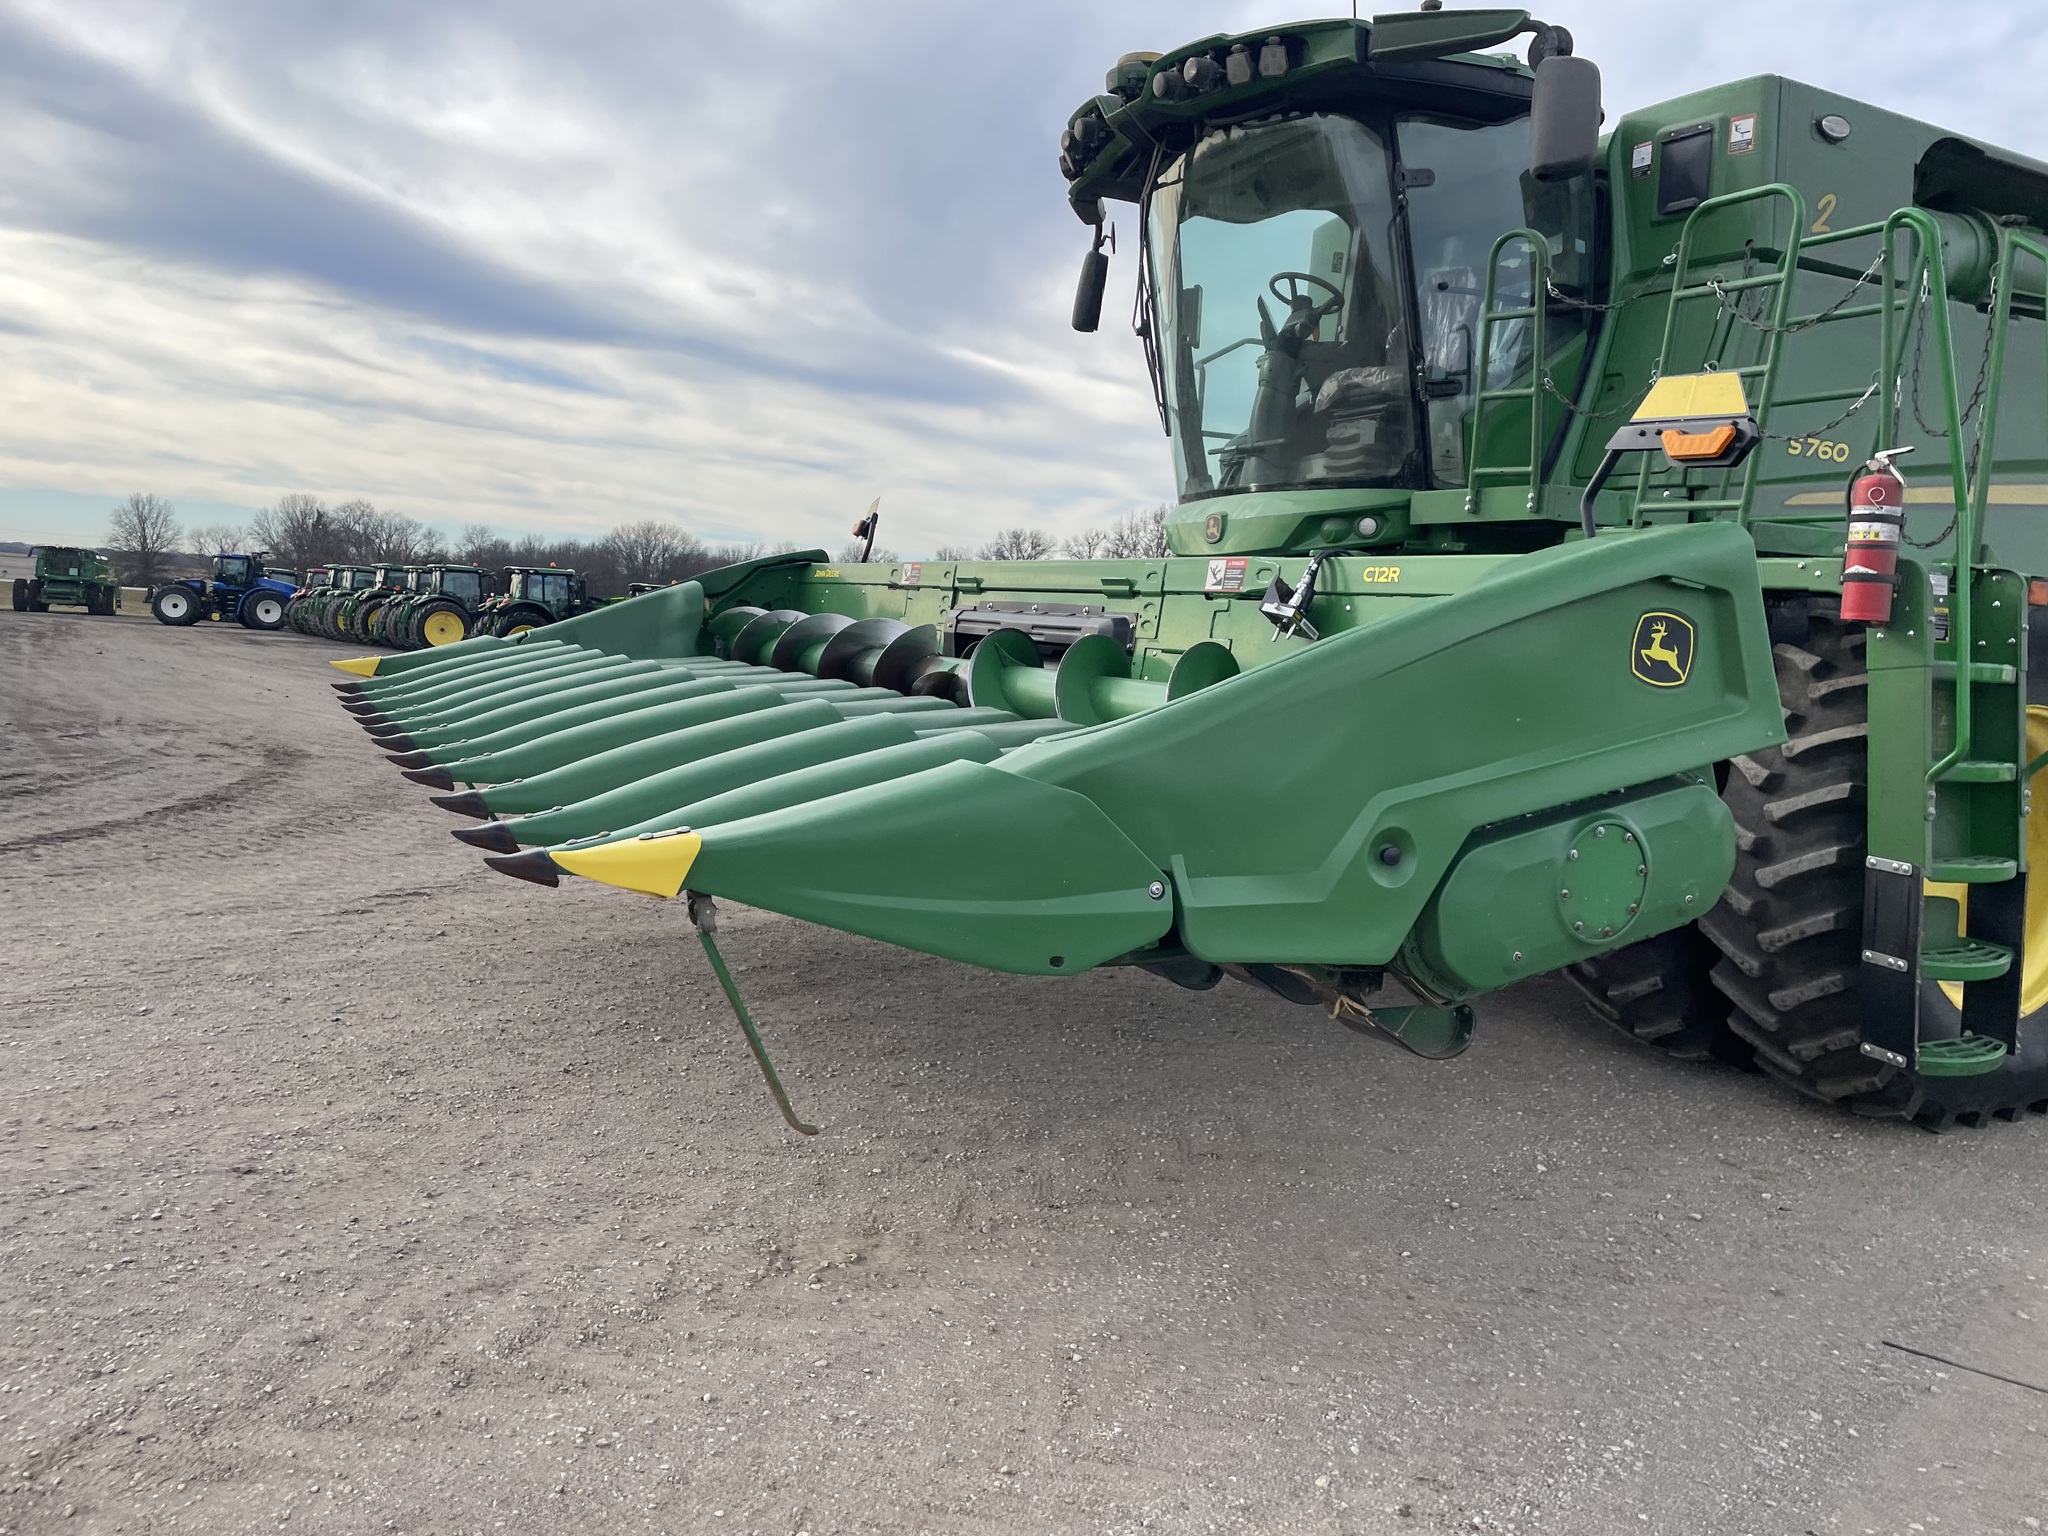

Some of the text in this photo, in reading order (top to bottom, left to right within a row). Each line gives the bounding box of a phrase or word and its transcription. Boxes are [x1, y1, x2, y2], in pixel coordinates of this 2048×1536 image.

[1811, 193, 1837, 233] 2
[1788, 437, 1850, 462] S760
[1363, 566, 1401, 583] C12R
